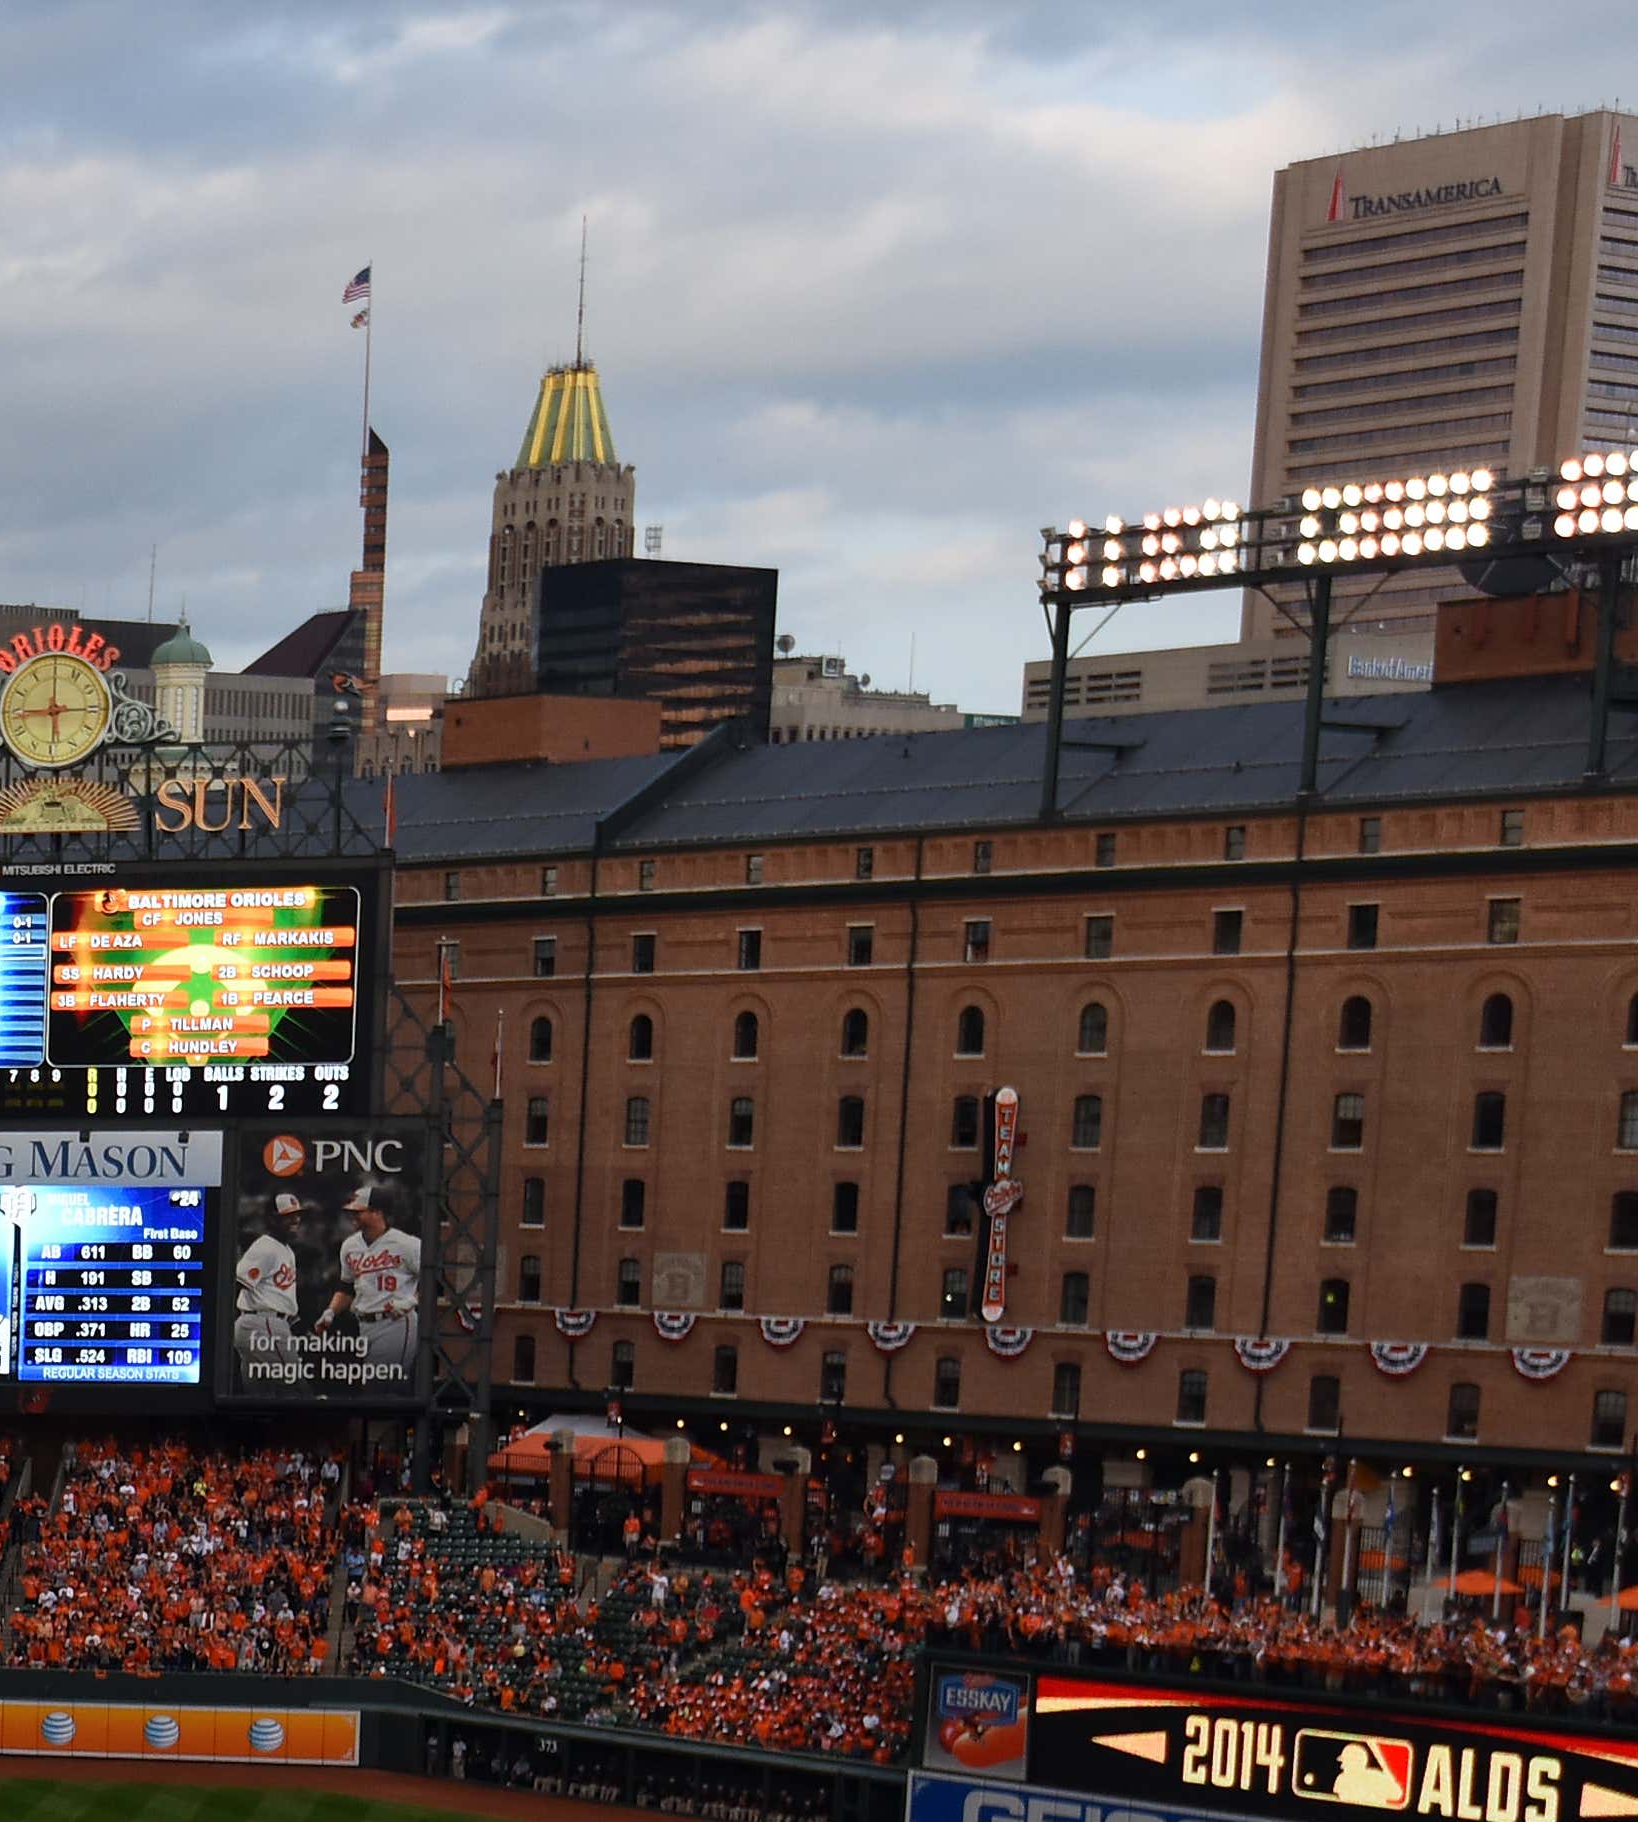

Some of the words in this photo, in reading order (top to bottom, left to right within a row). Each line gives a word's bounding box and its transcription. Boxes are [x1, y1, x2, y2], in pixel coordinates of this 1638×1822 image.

[1349, 175, 1503, 220] TRANSAMERICA
[154, 777, 286, 832] SUN
[2, 864, 63, 876] MITSUBISHI
[64, 863, 116, 875] ELECTRIC
[128, 893, 226, 910] BALTIMORE
[230, 892, 306, 908] ORIOLES
[175, 912, 224, 925] JONES
[90, 936, 112, 948] DE
[113, 935, 143, 947] AZA
[222, 933, 242, 945] RF
[254, 932, 334, 945] MARKAKIS
[61, 969, 80, 980] SS
[93, 967, 144, 980] HARDY
[218, 966, 237, 978] 2B
[251, 965, 314, 978] SCHOOP
[57, 995, 76, 1007] 3B
[89, 994, 165, 1007] FLAHERTY
[253, 992, 314, 1005] PEARCE
[169, 1018, 234, 1031] TILLMAN
[168, 1041, 237, 1054] HUNDLEY
[165, 1066, 191, 1081] LOB
[203, 1065, 245, 1082] BALLS
[249, 1065, 306, 1082] STRIKES
[313, 1065, 350, 1081] OUTS
[268, 1084, 284, 1110] 2
[322, 1084, 339, 1109] 2
[997, 1108, 1013, 1175] TEAM
[28, 1139, 190, 1180] MASON
[311, 1139, 404, 1174] PNC
[61, 1206, 144, 1227] CABRERA
[143, 1227, 169, 1241] First
[170, 1227, 199, 1241] Base
[41, 1244, 62, 1260] AB
[81, 1244, 106, 1260] 611
[131, 1244, 154, 1260] BB
[173, 1244, 192, 1260] 60
[989, 1215, 1006, 1301] STORE
[80, 1271, 105, 1286] 191
[131, 1271, 153, 1286] SB
[377, 1274, 397, 1292] 19
[35, 1296, 65, 1311] AVG
[131, 1296, 152, 1311] 2B
[34, 1322, 65, 1338] OBP
[76, 1322, 106, 1338] .371
[129, 1322, 151, 1338] HR
[249, 1330, 281, 1352] for
[286, 1329, 369, 1358] making
[34, 1348, 63, 1364] SLG
[76, 1348, 106, 1364] .524
[127, 1348, 153, 1364] RBI
[166, 1348, 193, 1364] 109
[42, 1367, 96, 1380] REGULAR
[98, 1367, 144, 1380] SEASON
[145, 1368, 180, 1380] STATS
[248, 1356, 315, 1384] magic
[321, 1356, 409, 1386] happen.
[945, 1687, 1013, 1712] ESSKAY
[1181, 1714, 1286, 1794] 2014
